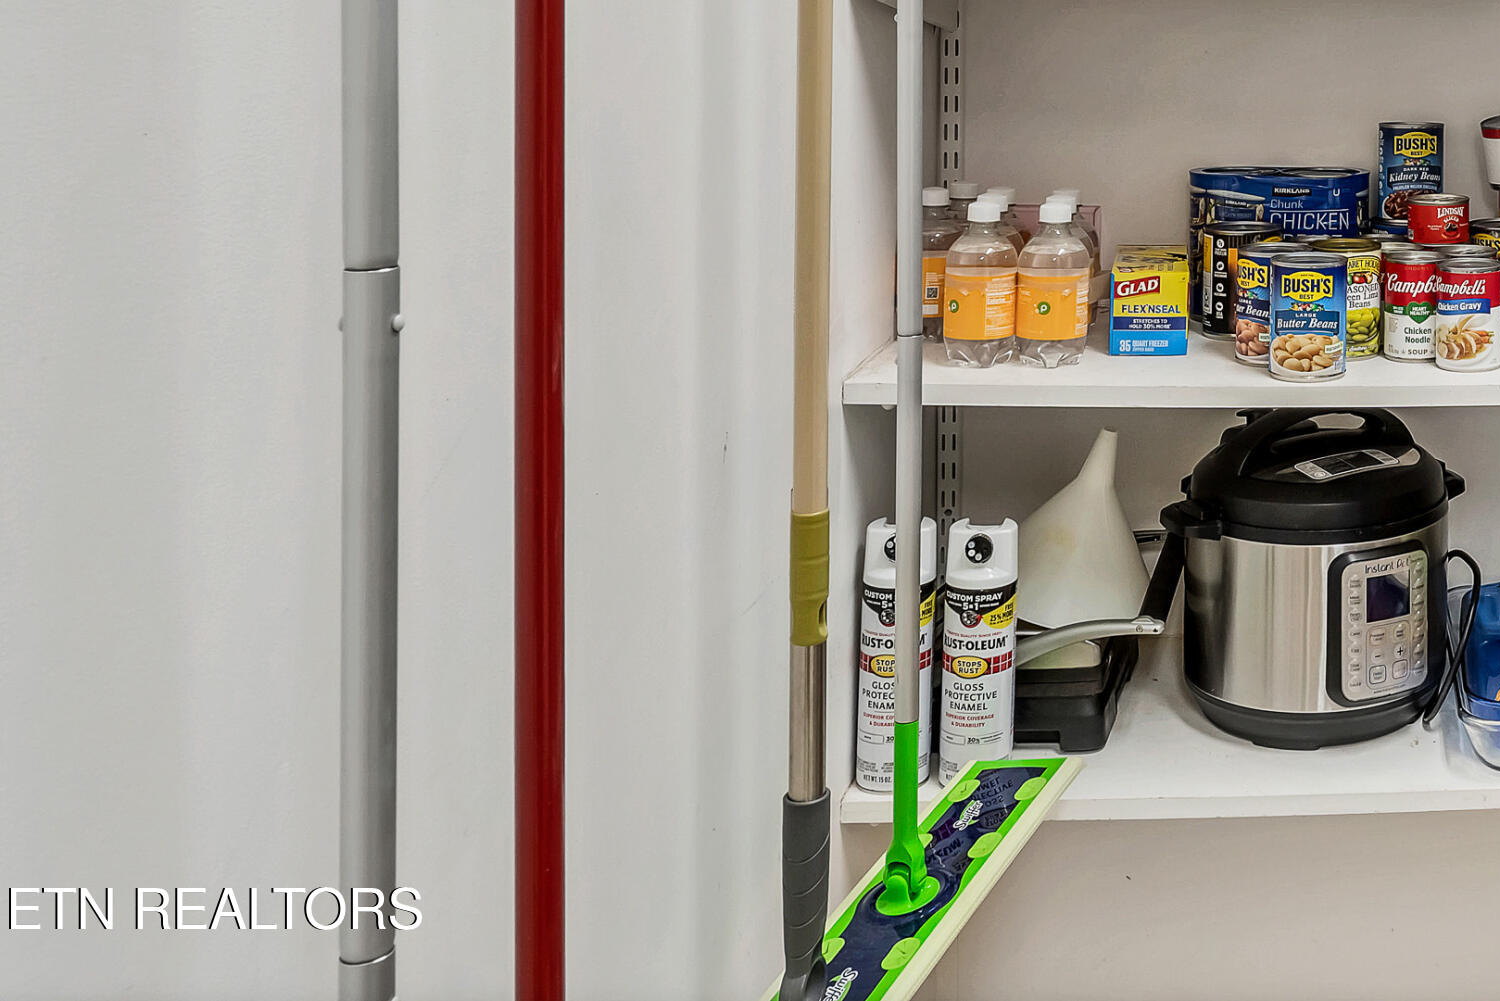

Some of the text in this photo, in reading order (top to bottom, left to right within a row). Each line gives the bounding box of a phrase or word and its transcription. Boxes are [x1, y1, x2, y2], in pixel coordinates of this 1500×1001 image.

[1396, 135, 1436, 152] BUSH'S
[1389, 171, 1441, 183] Kidney Beans
[1274, 187, 1310, 195] KIRKLAND
[1269, 199, 1304, 209] Chunk
[1437, 207, 1464, 218] LINDSAY
[1270, 211, 1350, 231] CHICKEN
[1116, 276, 1160, 297] GLAD
[1284, 278, 1331, 293] BUSH'S
[1436, 277, 1487, 296] Campbell's
[1363, 292, 1379, 301] Lima
[1349, 300, 1371, 308] Beans
[1459, 301, 1482, 312] Gravy
[1277, 317, 1338, 329] Butter Beans
[1404, 326, 1432, 335] Chicken
[1404, 335, 1431, 344] Noodle
[1119, 340, 1131, 353] 35
[1364, 561, 1395, 575] Instant
[864, 589, 893, 601] CUSTOM
[946, 590, 1003, 602] CUSTOM SPRAY
[944, 636, 1007, 651] RUST-OLEUM
[953, 682, 984, 691] GLOSS
[862, 688, 895, 700] PROTEC
[944, 690, 998, 702] PROTECTIVE
[868, 700, 895, 710] ENAM
[949, 701, 988, 711] ENAMEL
[945, 713, 994, 721] SUPERIOR COVERAGE
[951, 799, 984, 832] Swiffer
